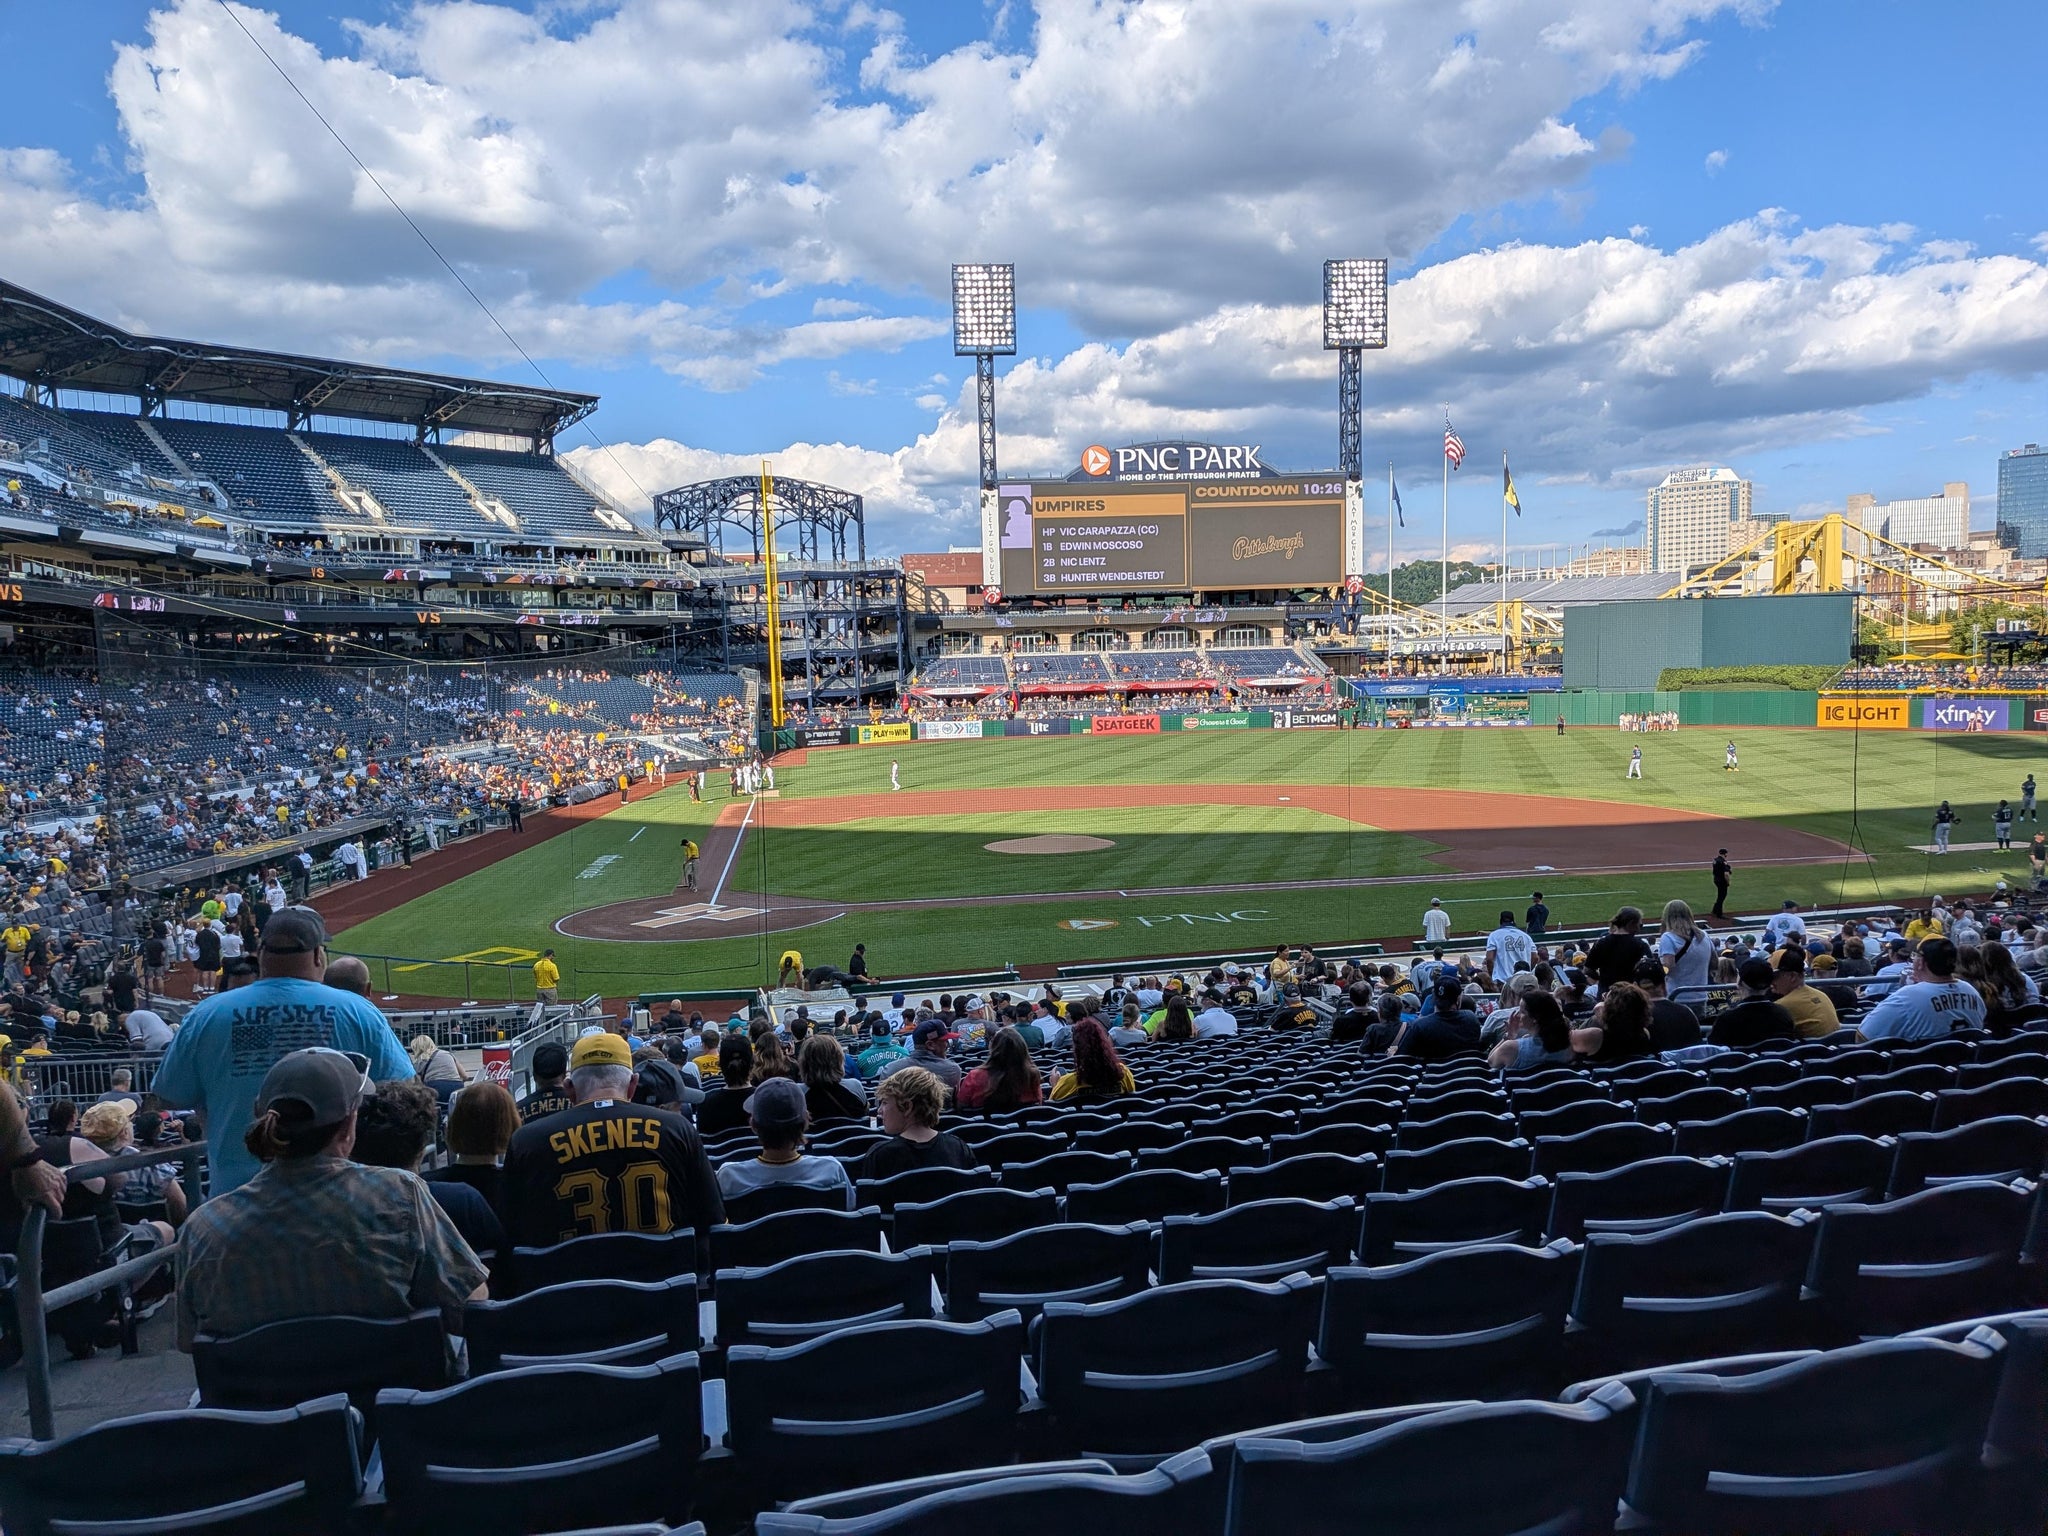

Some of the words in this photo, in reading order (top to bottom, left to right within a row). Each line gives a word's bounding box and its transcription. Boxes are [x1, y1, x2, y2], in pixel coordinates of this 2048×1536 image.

[1116, 447, 1179, 472] PNC
[1186, 445, 1262, 470] PARK
[1176, 472, 1225, 480] PITTSBURGH
[1195, 484, 1299, 498] COUNTDOWN
[1303, 482, 1342, 495] 10:26
[1035, 500, 1105, 513] UMPIRES
[1042, 527, 1055, 537] HP
[1059, 527, 1076, 536] VIC
[1077, 525, 1136, 536] CARAPAZZA
[1138, 525, 1159, 536] (CC)
[988, 540, 994, 553] GO
[1042, 542, 1053, 551] 1B
[1060, 542, 1092, 551] EDWIN
[1093, 541, 1143, 550] MOSCOSO
[1232, 531, 1304, 561] Pittsburgh
[1043, 558, 1056, 567] 2B
[1060, 558, 1078, 567] NIC
[1078, 557, 1106, 567] LENTZ
[311, 567, 325, 579] VS
[1043, 574, 1056, 583] 3B
[1061, 572, 1097, 582] HUNTER
[1098, 571, 1165, 581] WENDELSTEDT
[0, 583, 23, 601] VS
[416, 611, 441, 624] VS
[1094, 614, 1111, 625] VS
[1416, 643, 1437, 652] FAT
[1440, 641, 1487, 651] HEAD'S
[1292, 713, 1337, 725] BETMGM
[1825, 706, 1844, 721] IC
[1848, 706, 1900, 721] LIGHT
[1096, 718, 1155, 732] SEATGEEK
[1230, 717, 1249, 725] Good
[873, 729, 888, 738] PLAY
[894, 729, 909, 737] WIN!
[964, 722, 980, 734] 125
[1030, 722, 1050, 735] Lite
[1130, 909, 1279, 928] PNC
[1504, 935, 1525, 952] 24
[1930, 992, 1978, 1012] GRIFFIN
[866, 1050, 902, 1065] RODRIGUEZ
[549, 1117, 662, 1164] SKENES
[553, 1160, 675, 1242] 30
